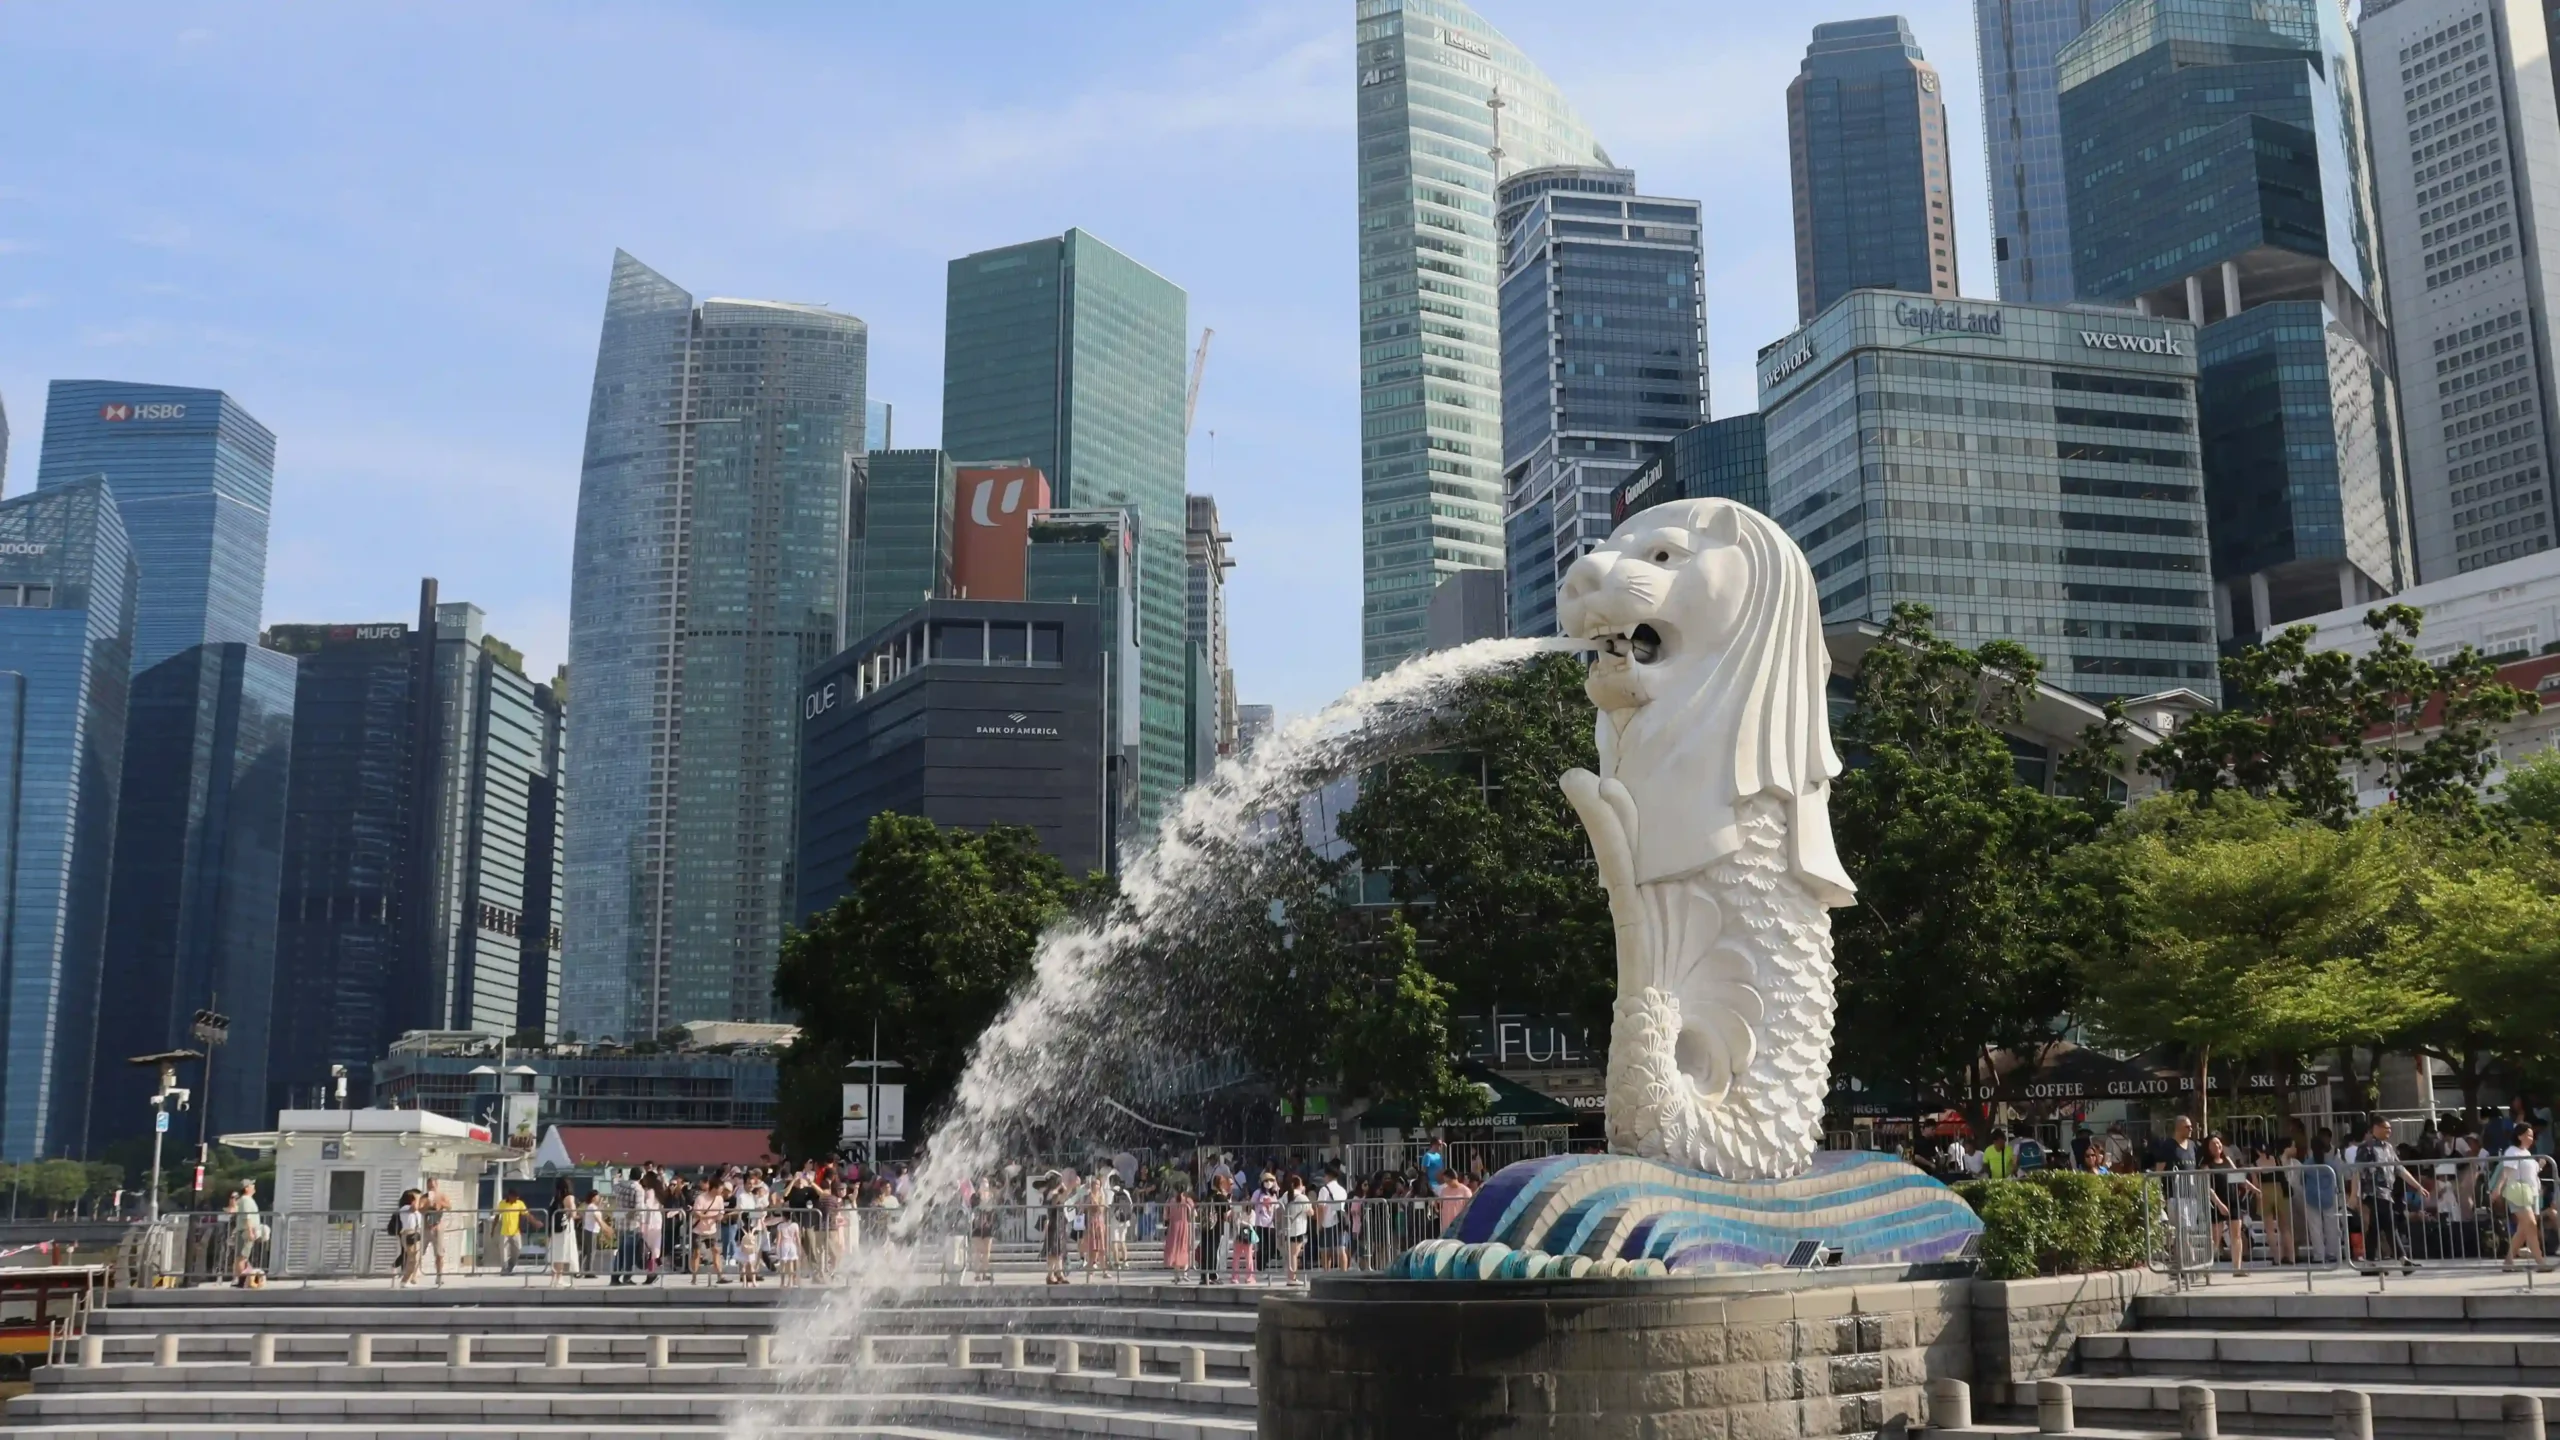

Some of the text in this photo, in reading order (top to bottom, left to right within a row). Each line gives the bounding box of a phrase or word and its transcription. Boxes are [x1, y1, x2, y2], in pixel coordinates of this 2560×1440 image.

[1895, 299, 2001, 335] CapitaLand
[2080, 329, 2184, 355] wework
[1764, 334, 1812, 389] wework
[134, 403, 186, 419] HSBC
[356, 626, 401, 639] MUFG
[806, 683, 836, 720] OUE
[976, 726, 1001, 734] BANK
[2025, 1082, 2084, 1097] COFFEE
[2107, 1080, 2168, 1095] GELATO
[1468, 1115, 1517, 1127] BURGER
